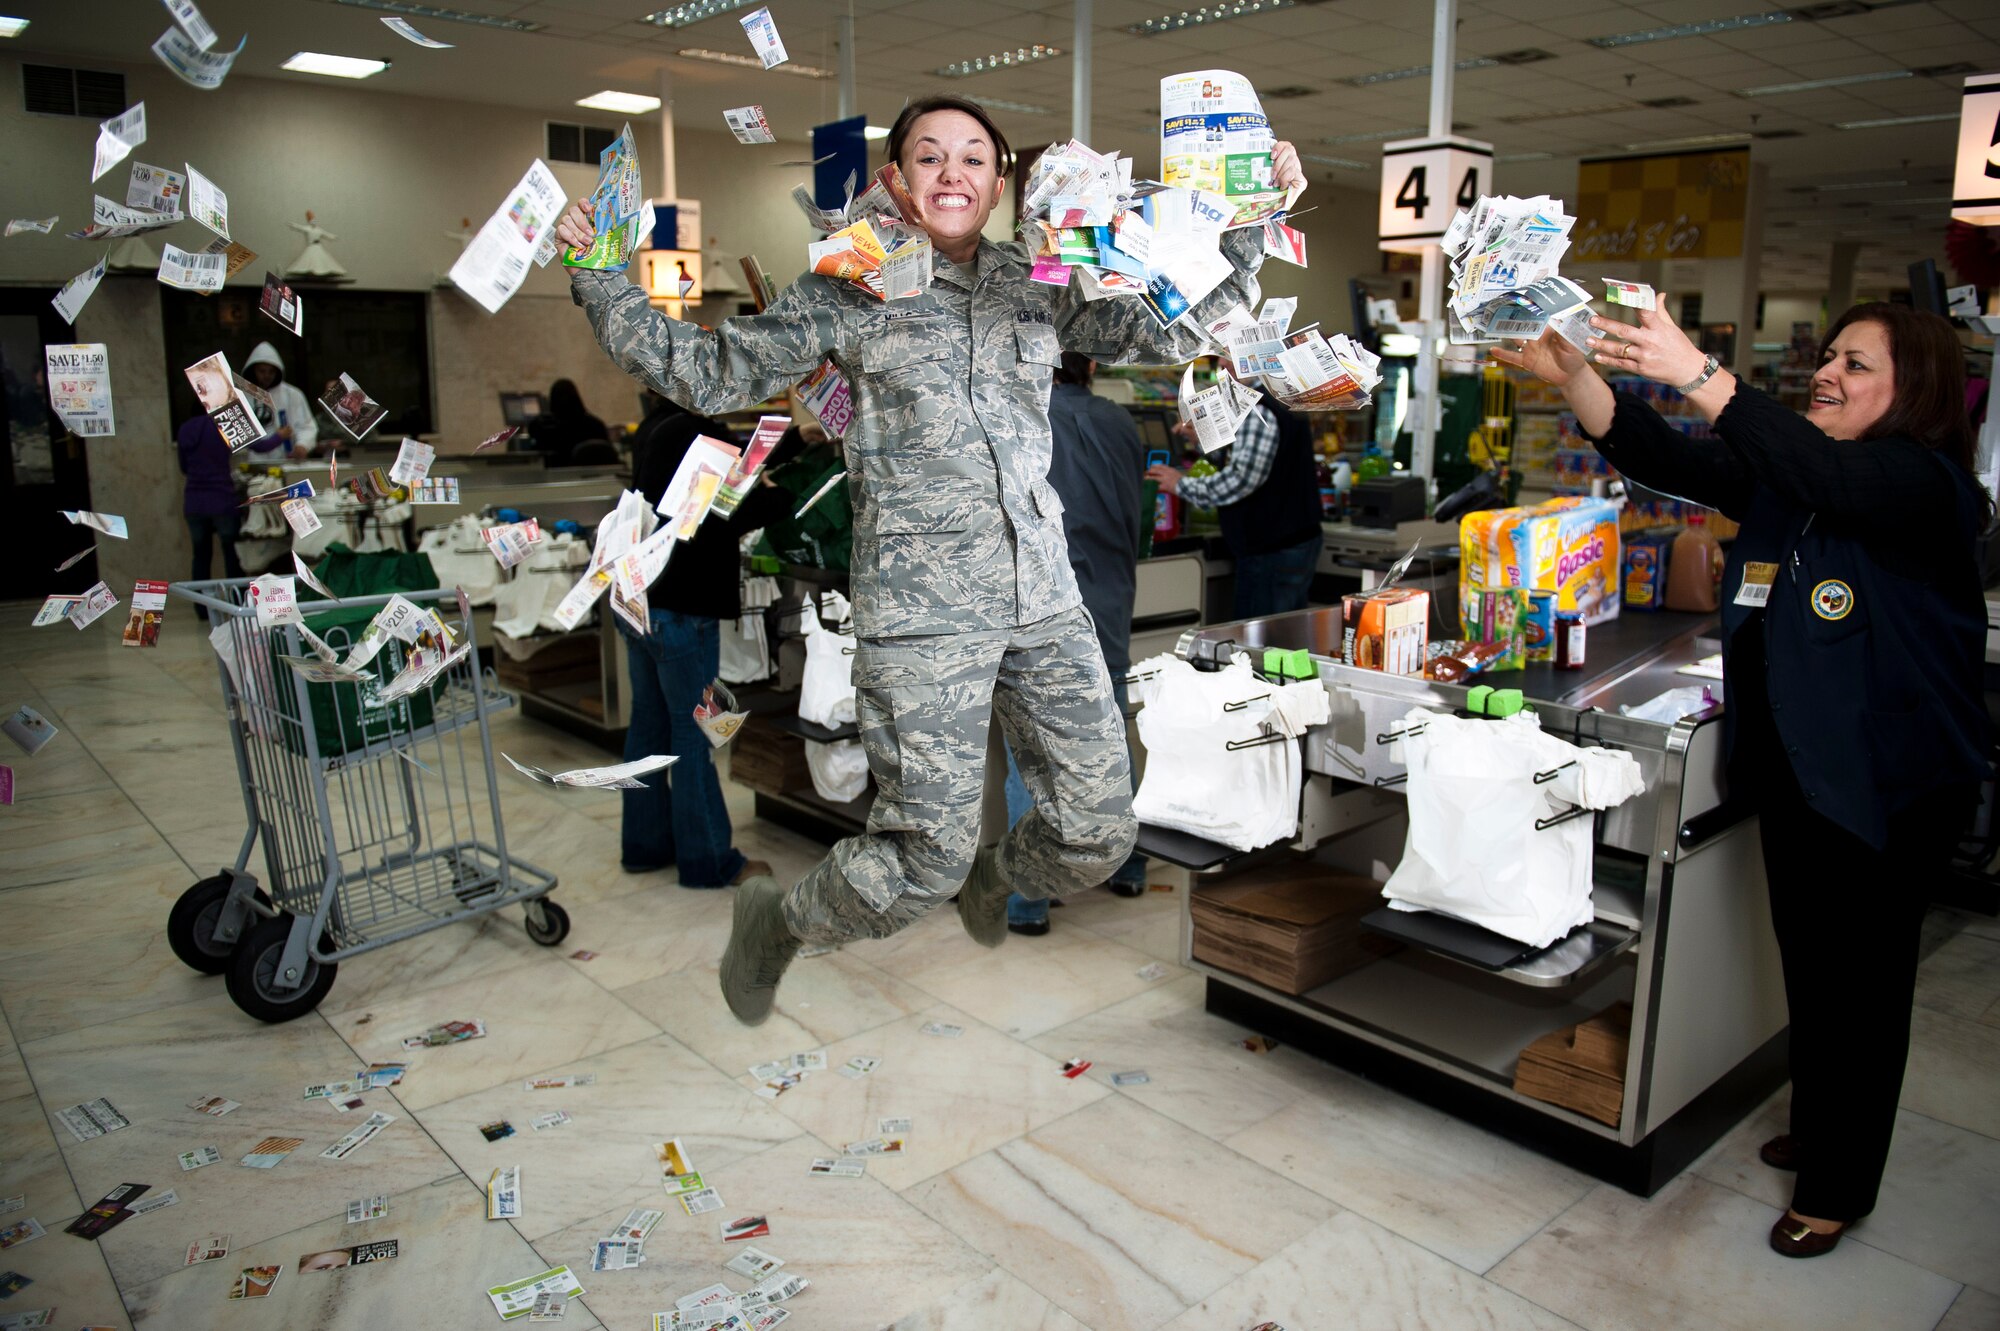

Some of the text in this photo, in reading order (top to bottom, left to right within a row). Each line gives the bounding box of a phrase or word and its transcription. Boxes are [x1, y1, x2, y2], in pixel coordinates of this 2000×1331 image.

[1166, 119, 1183, 130] SAVE
[1227, 116, 1248, 125] SAVE
[1395, 165, 1430, 219] 4
[1456, 166, 1478, 208] 4
[847, 231, 878, 253] NEW!
[1016, 310, 1031, 323] U.S.
[1034, 311, 1046, 324] AIR
[49, 353, 104, 367] SAVE $1.50
[1188, 389, 1218, 406] SAVE $1.00
[1321, 384, 1333, 394] Year
[820, 391, 848, 425] TOPS
[224, 408, 249, 442] SEE SPOTS
[232, 404, 256, 438] SEE SPOTS?
[213, 411, 244, 449] FADE
[1562, 517, 1597, 551] Charmin
[1556, 534, 1605, 588] Basic
[268, 606, 292, 614] GREEK
[371, 1241, 397, 1249] SPOTS?
[372, 1245, 397, 1253] SPOTS
[356, 1250, 397, 1264] FADE
